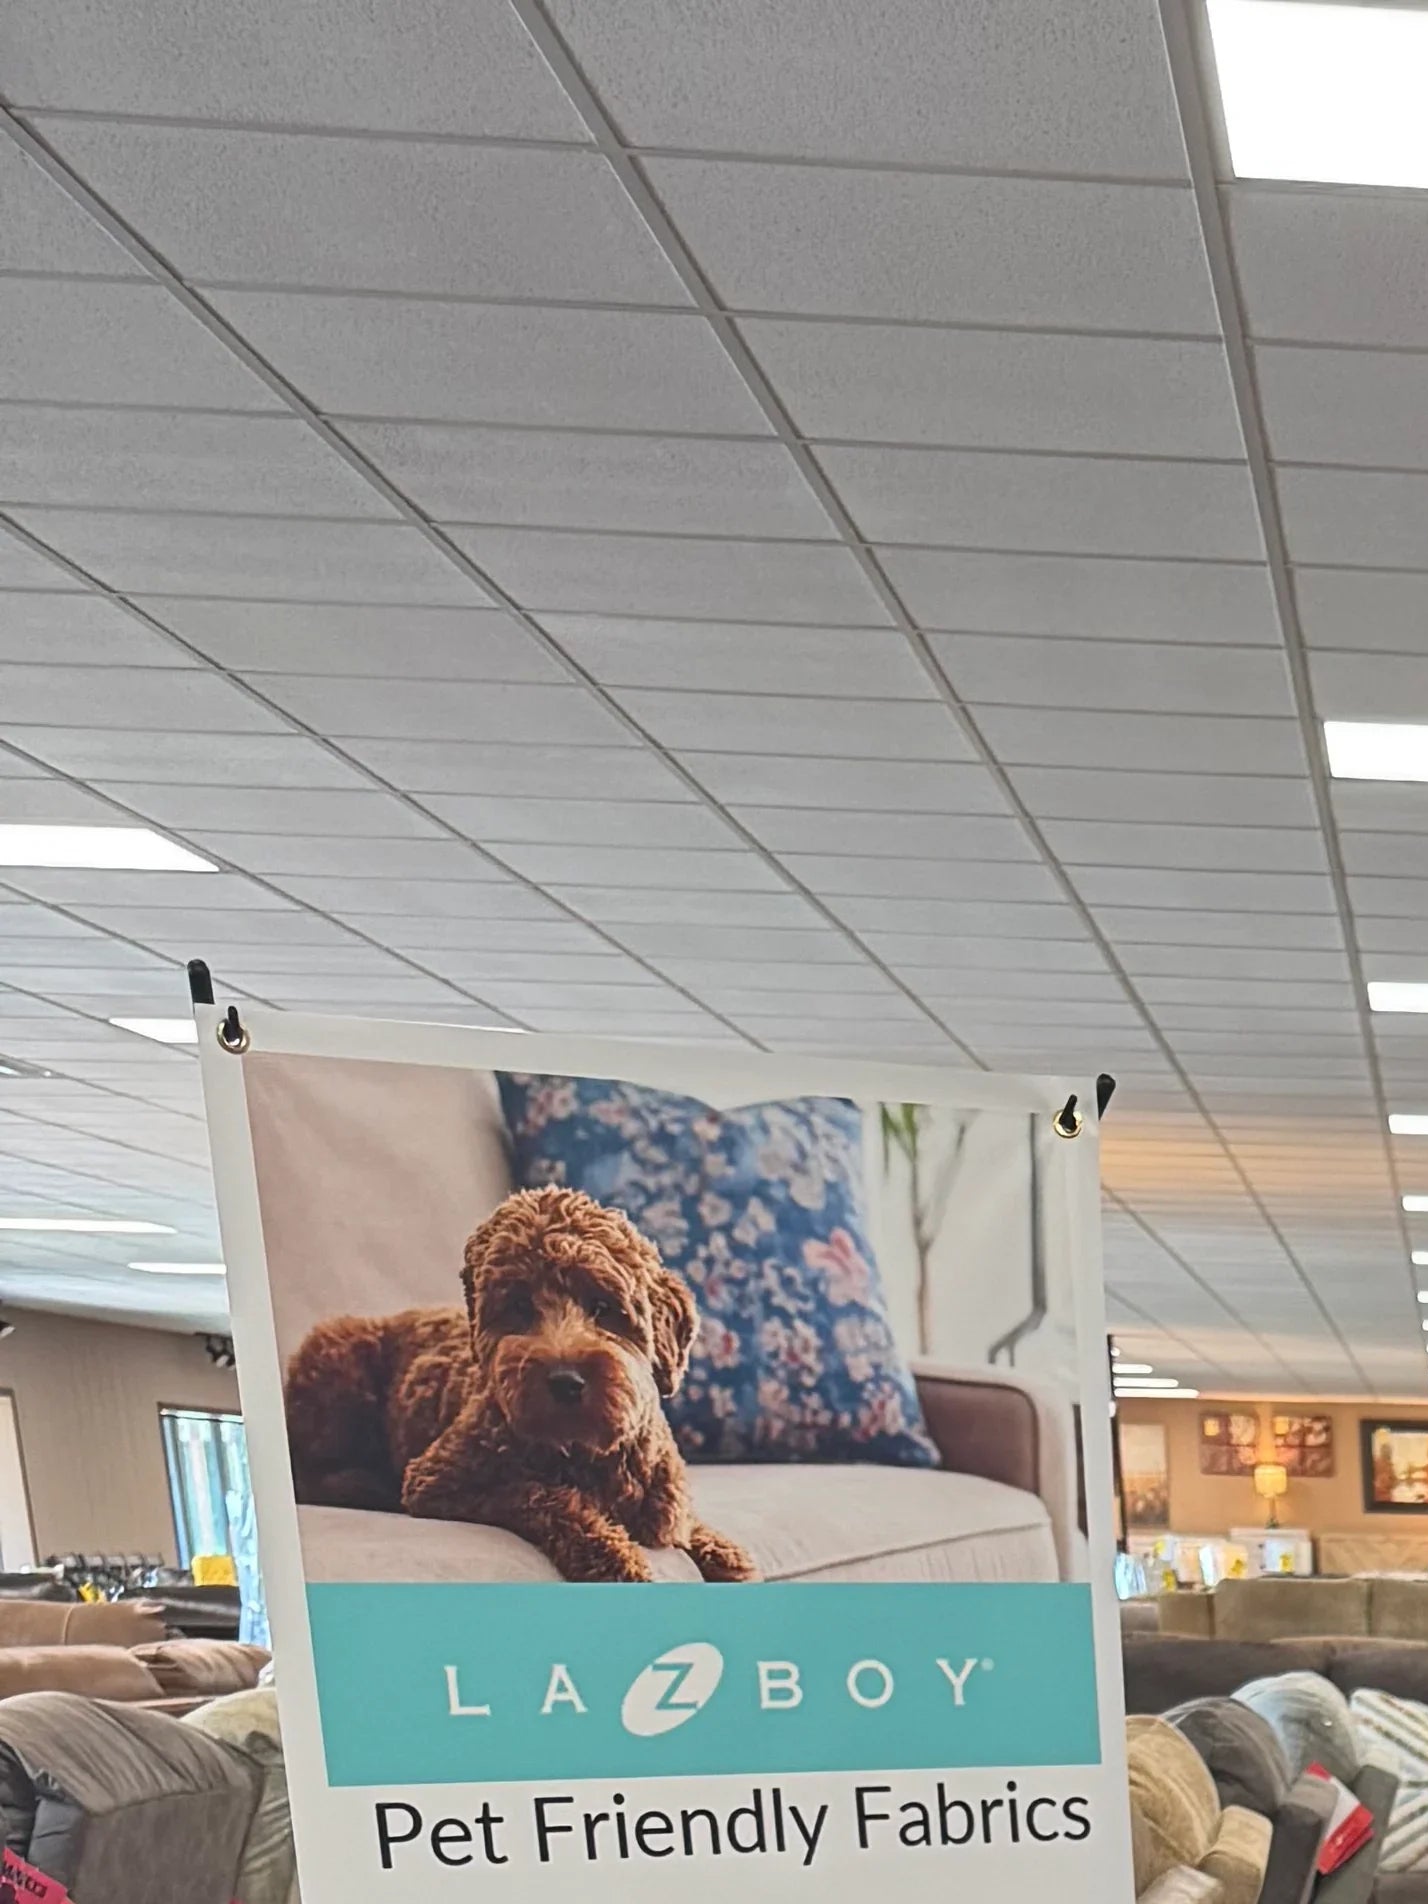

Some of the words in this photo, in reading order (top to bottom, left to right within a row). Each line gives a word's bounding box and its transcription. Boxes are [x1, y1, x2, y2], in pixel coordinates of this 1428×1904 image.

[374, 1801, 509, 1870] Pet
[533, 1787, 829, 1867] Friendly
[854, 1780, 1091, 1849] Fabrics
